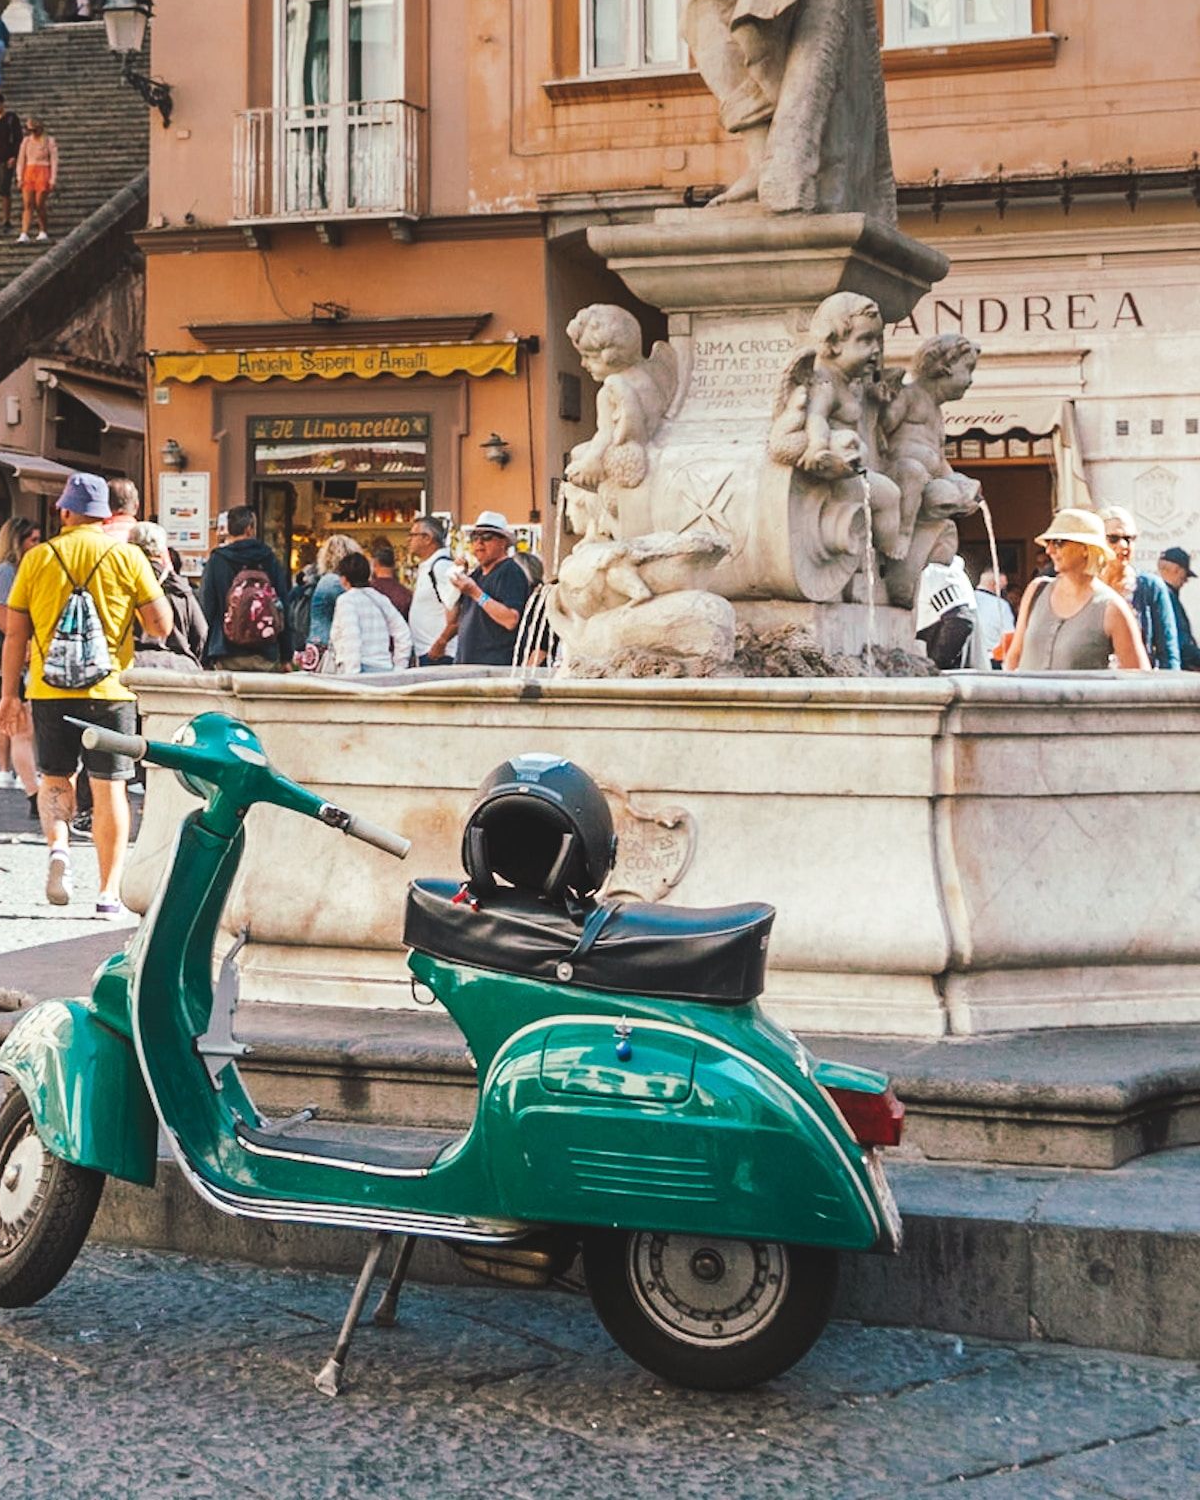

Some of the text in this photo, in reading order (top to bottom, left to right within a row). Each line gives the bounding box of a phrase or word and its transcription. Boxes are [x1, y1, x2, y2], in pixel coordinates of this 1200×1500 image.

[892, 291, 1144, 336] ANDREA
[695, 341, 734, 356] RIMA
[237, 352, 293, 374] Antichi
[301, 350, 355, 372] Sapori
[272, 417, 411, 439] Il Limoncello
